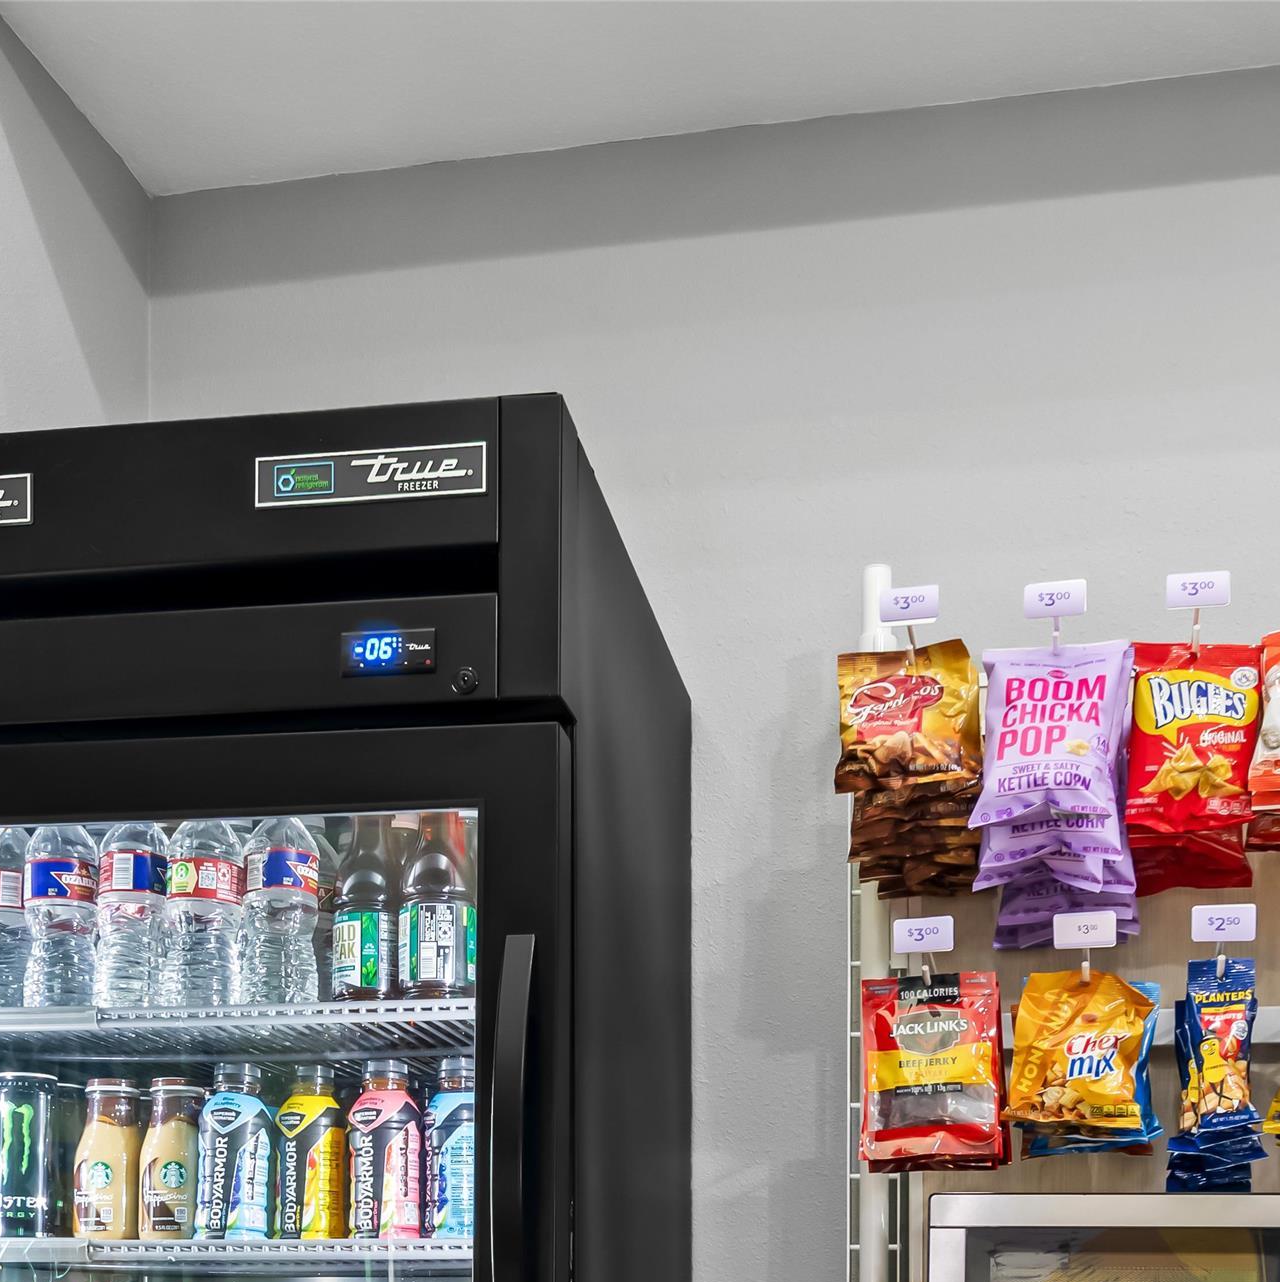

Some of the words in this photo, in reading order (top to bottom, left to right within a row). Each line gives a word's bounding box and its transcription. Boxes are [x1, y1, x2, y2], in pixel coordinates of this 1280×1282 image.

[351, 455, 467, 483] true
[398, 480, 439, 491] FREEZER
[1005, 675, 1107, 707] BOOM
[1001, 701, 1100, 728] CHICKA
[996, 725, 1067, 761] POP
[998, 772, 1049, 793] KETTLE
[1053, 771, 1091, 791] CORN
[1012, 763, 1040, 775] SWEET
[1053, 763, 1081, 772] SALTY
[900, 990, 915, 1000] 100
[916, 986, 959, 999] CALORIES
[1195, 989, 1252, 1004] PLANTERS
[890, 1023, 925, 1037] JACK
[1065, 1031, 1129, 1057] Chex
[898, 1058, 922, 1068] BEEF
[924, 1056, 957, 1067] JERKY
[210, 1136, 229, 1230] BODYARMOR
[285, 1140, 297, 1233] BODYARMOR
[360, 1134, 374, 1231] BODYARMOR
